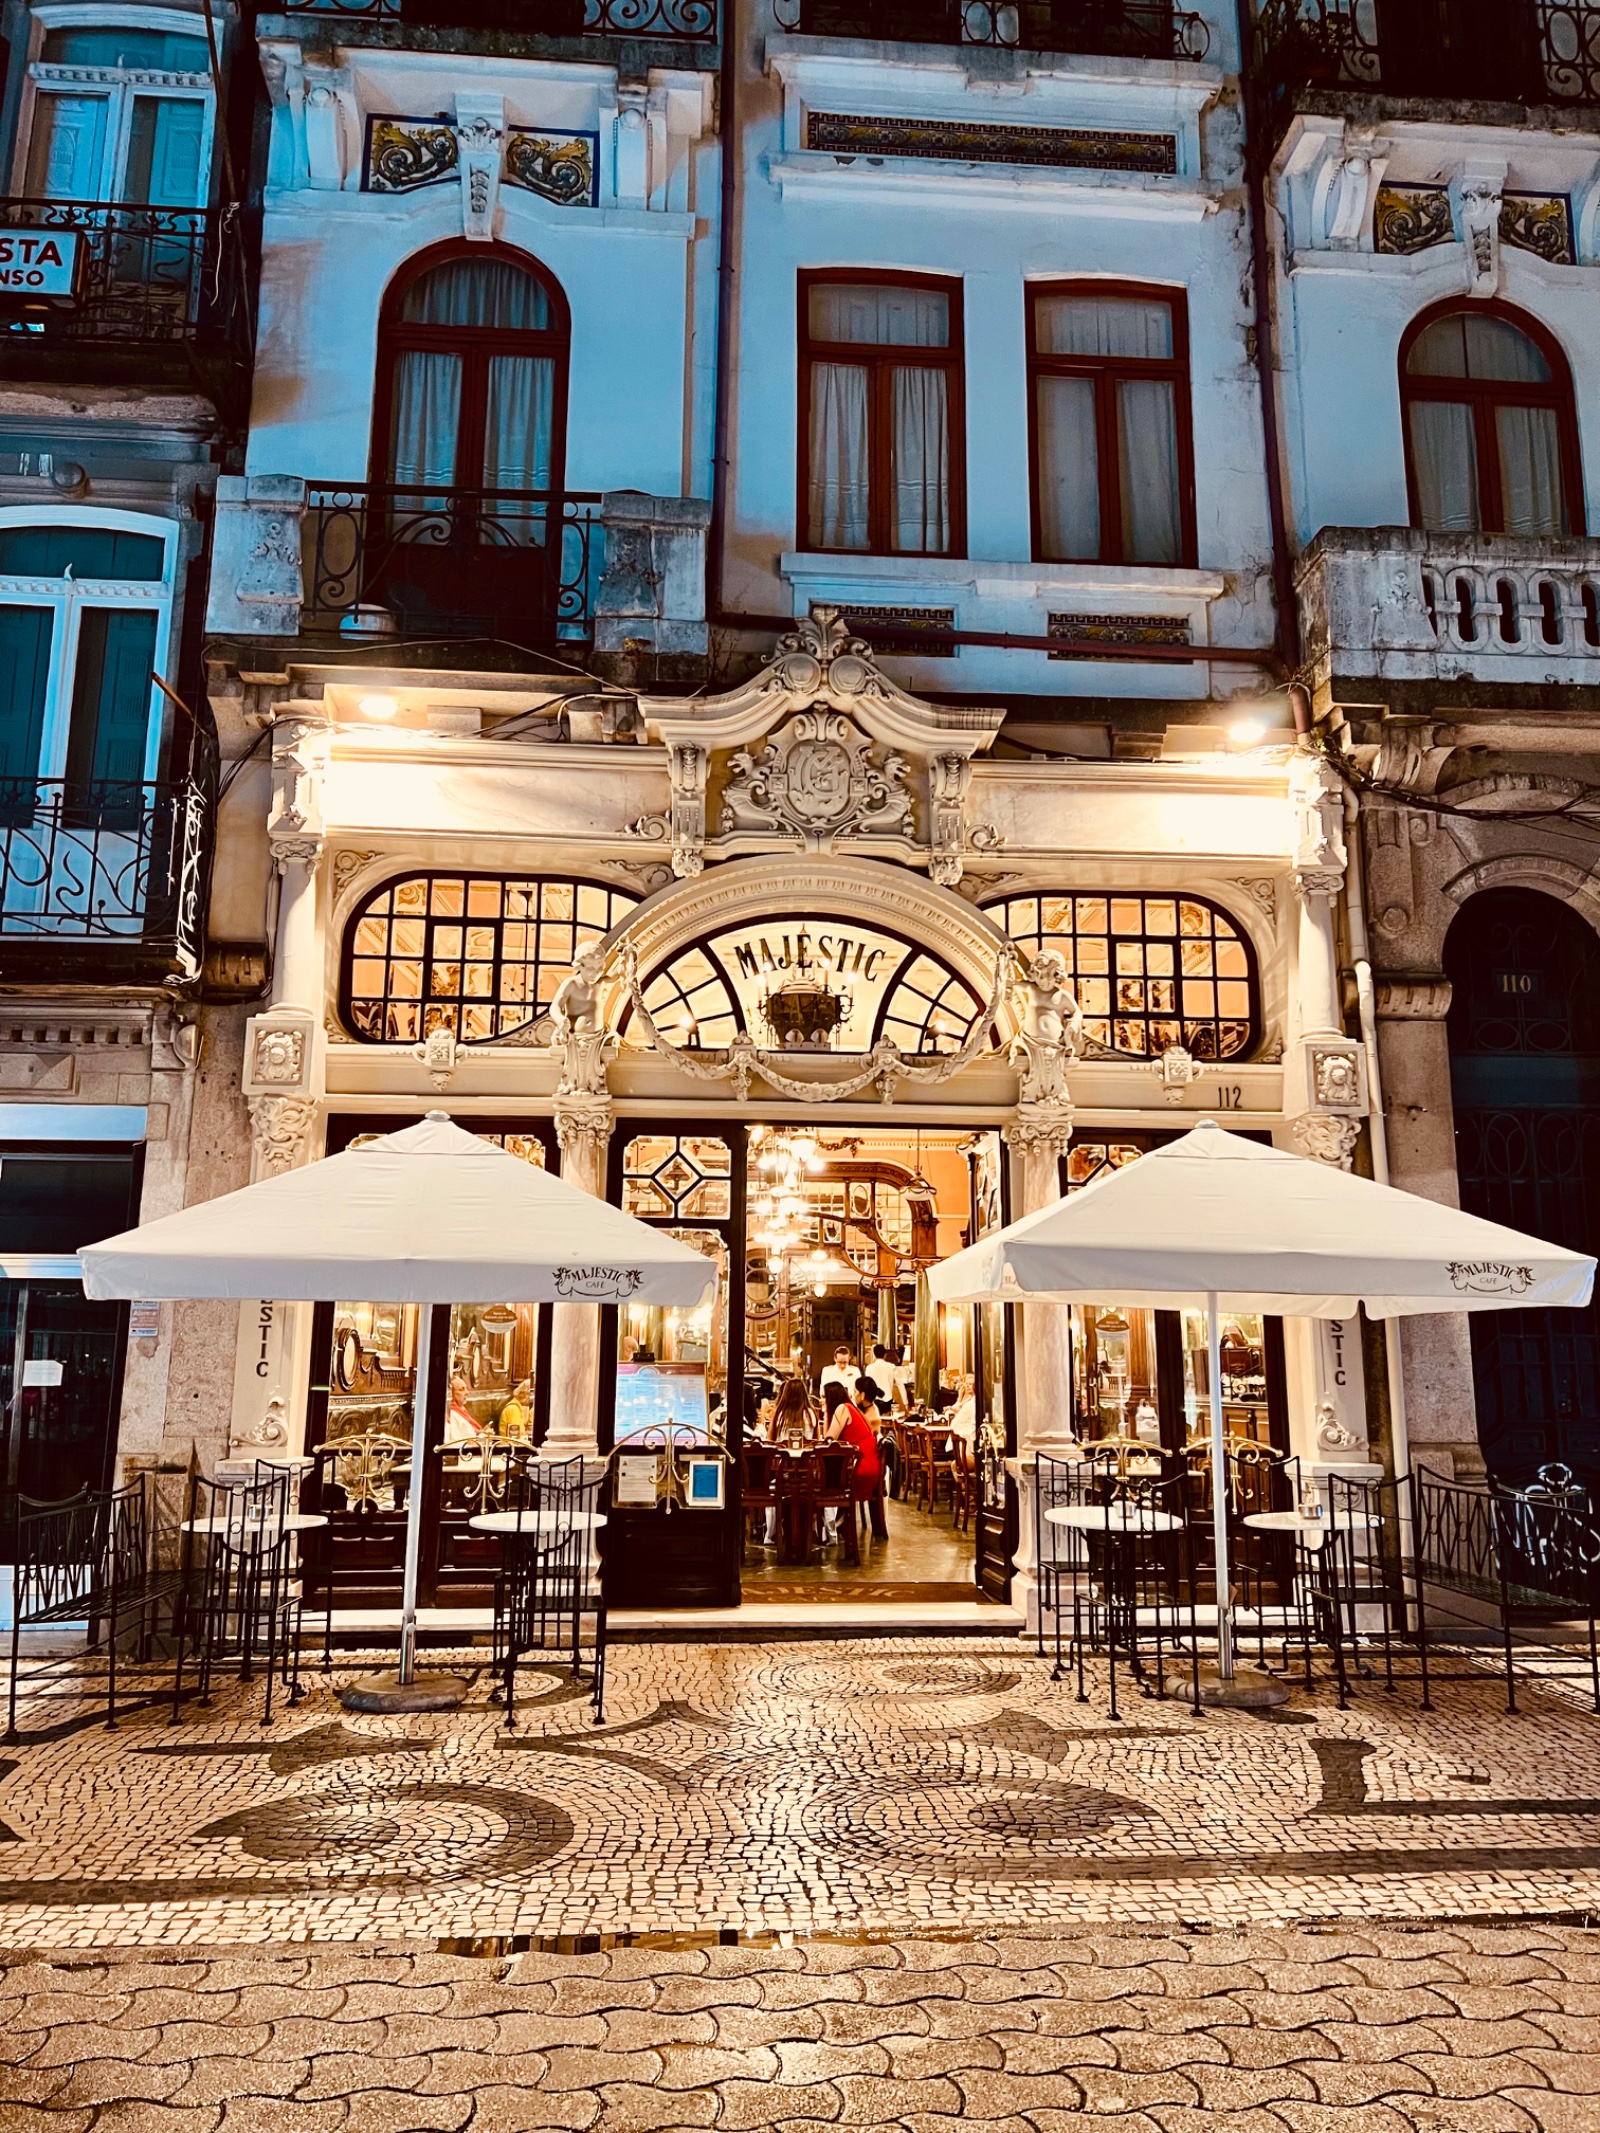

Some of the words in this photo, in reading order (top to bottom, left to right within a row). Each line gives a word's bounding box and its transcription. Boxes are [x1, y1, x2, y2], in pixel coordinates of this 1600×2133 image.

[0, 238, 63, 267] STA
[733, 934, 886, 982] MAJESTIC
[1503, 975, 1531, 993] 110
[1218, 1085, 1243, 1109] 112
[570, 1267, 624, 1283] MAJESTIC
[1463, 1262, 1516, 1279] MAJESTIC
[256, 1300, 273, 1377] STIC
